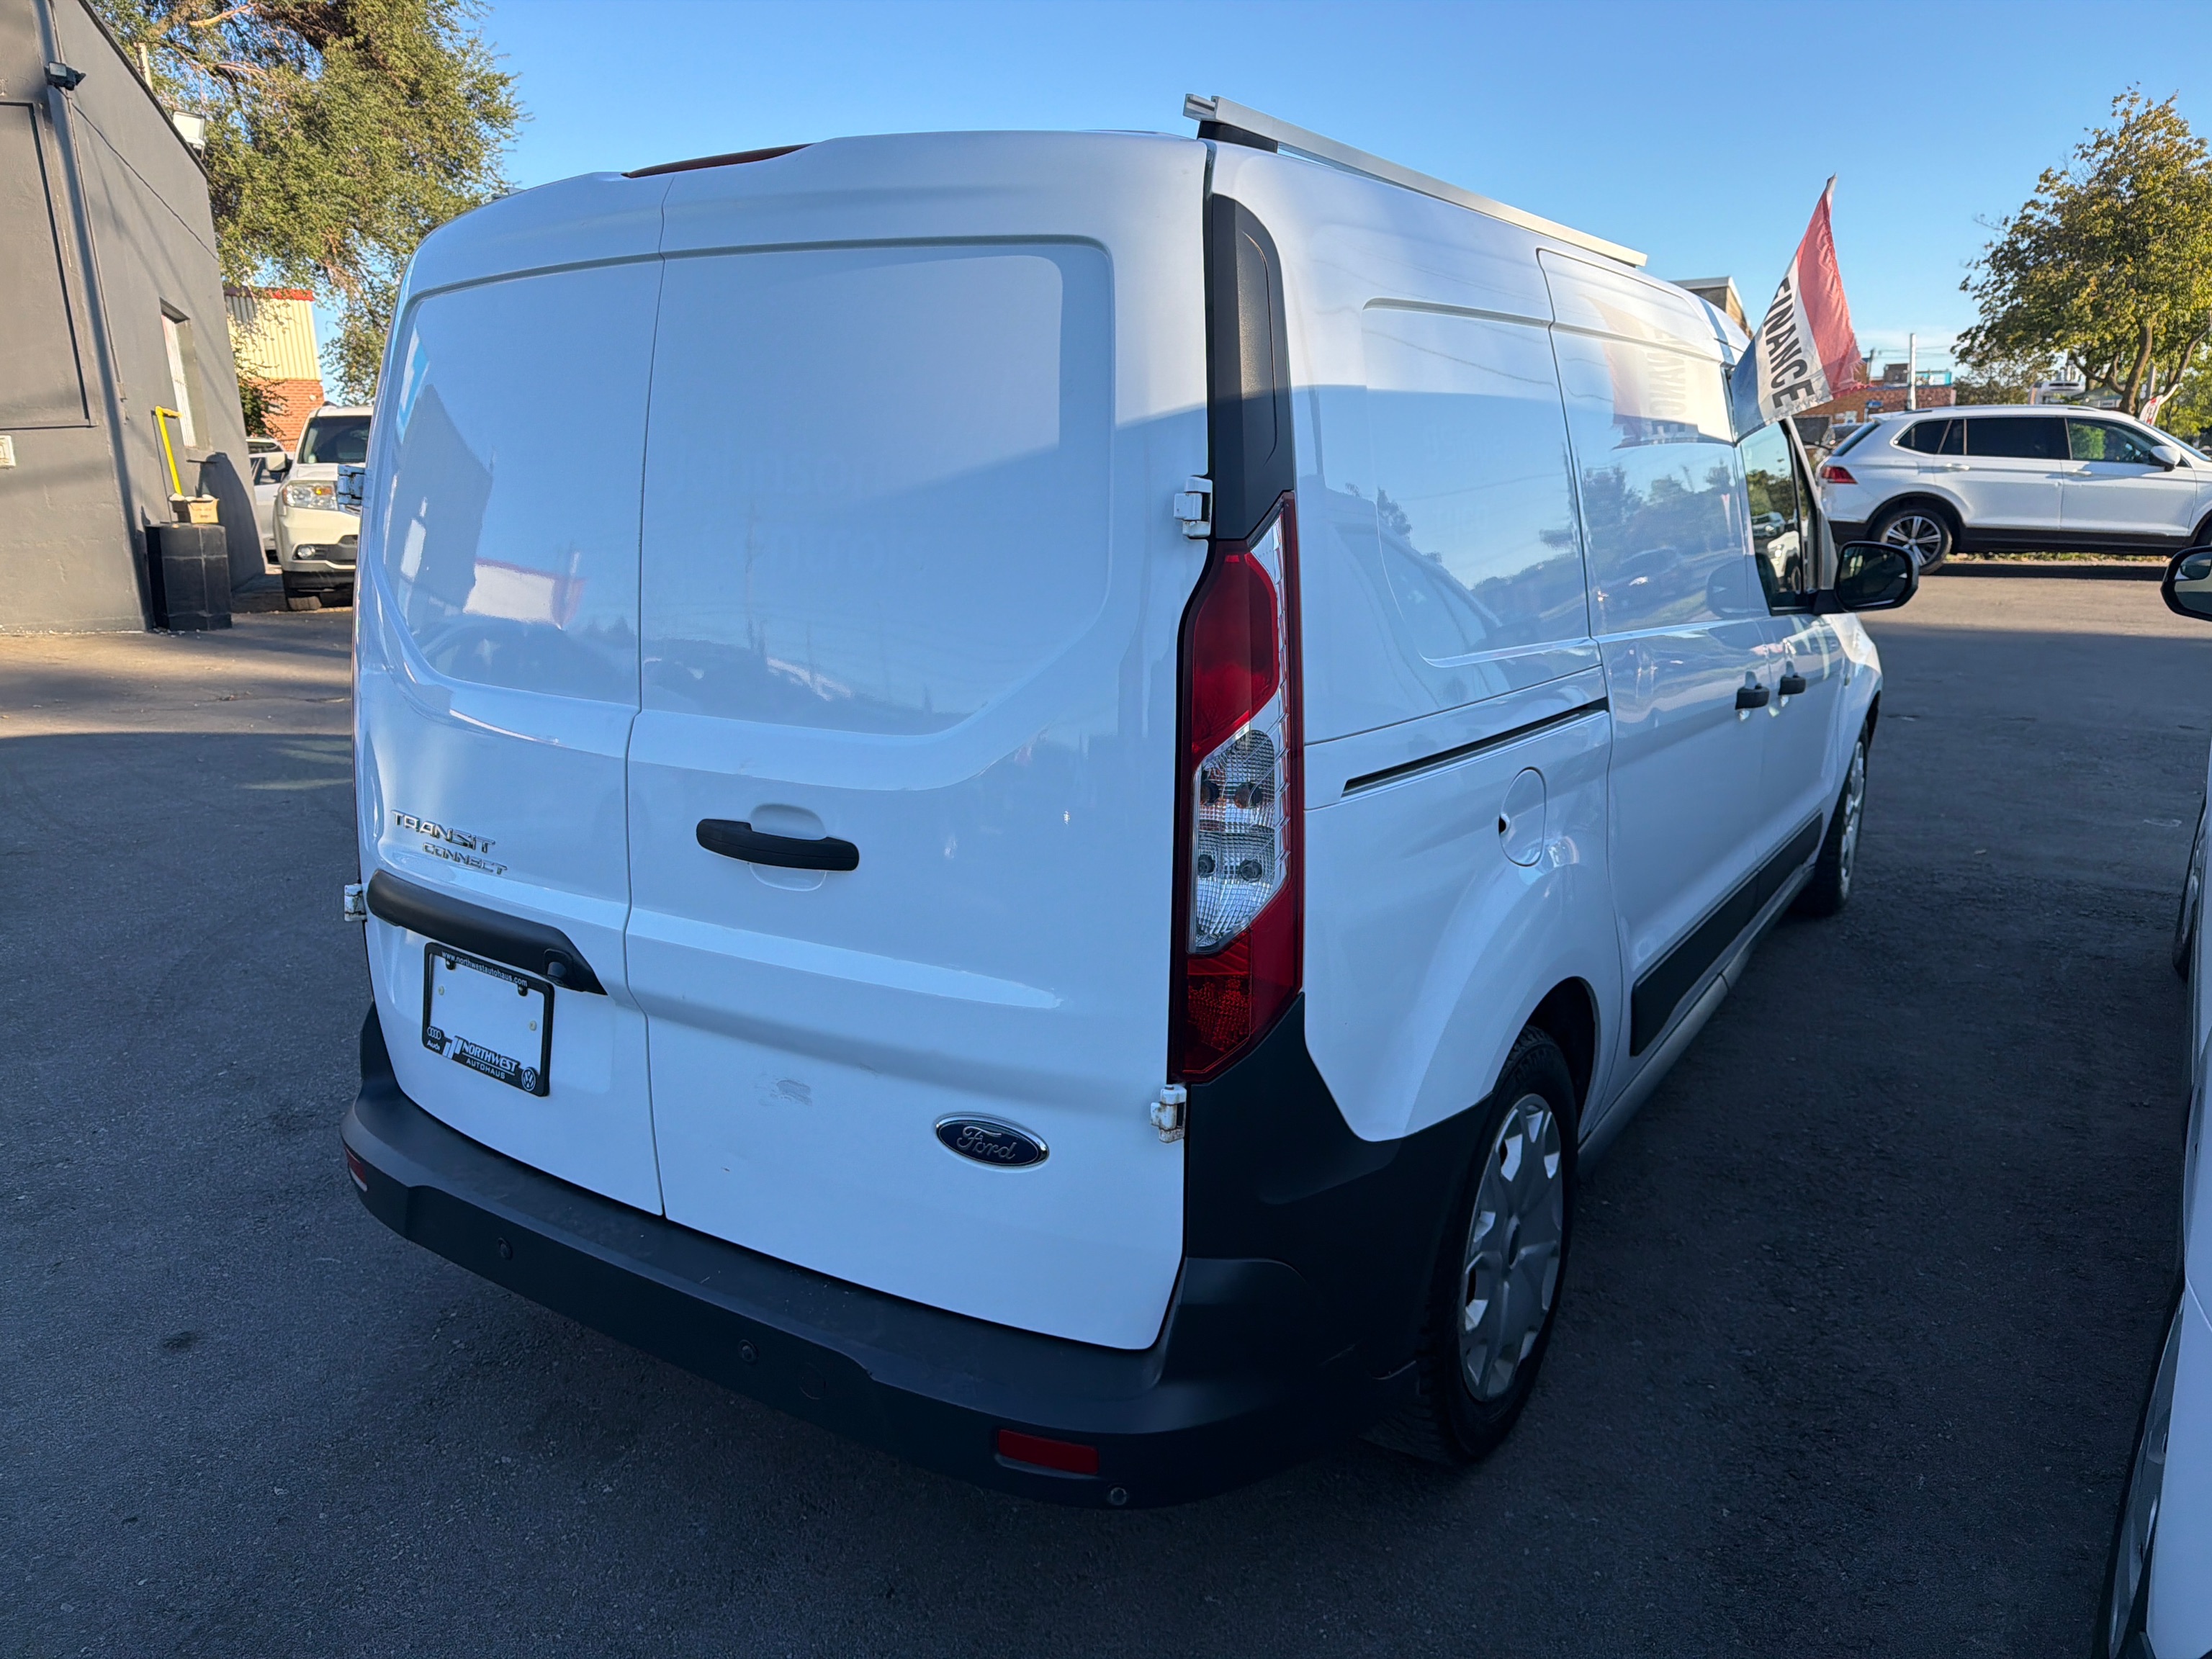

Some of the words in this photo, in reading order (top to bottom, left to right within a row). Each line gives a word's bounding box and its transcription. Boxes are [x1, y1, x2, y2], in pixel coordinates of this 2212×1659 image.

[1763, 277, 1815, 408] FINANCE
[391, 809, 495, 853] TRANSIT
[423, 842, 508, 875] CONNECT
[441, 950, 527, 986] www.northwestautohaus.com
[426, 1039, 441, 1051] Audi
[462, 1041, 518, 1072] NORTHWEST
[465, 1057, 505, 1080] AUTOHAUS
[956, 1125, 1017, 1160] Ford
